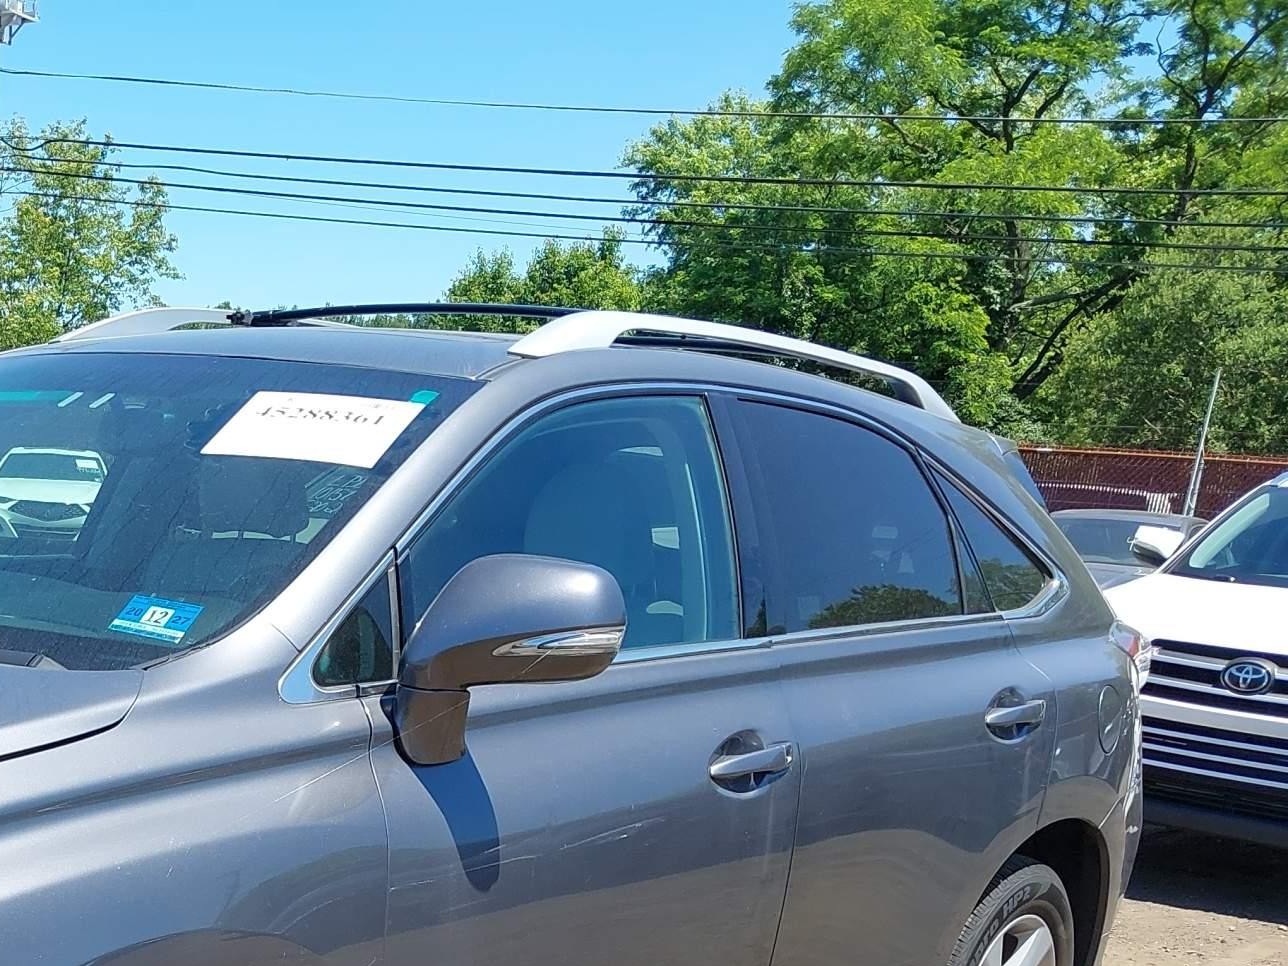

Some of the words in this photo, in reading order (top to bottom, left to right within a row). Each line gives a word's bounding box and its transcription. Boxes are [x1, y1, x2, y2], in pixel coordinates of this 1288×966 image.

[125, 607, 143, 617] 20
[144, 609, 169, 624] 12
[172, 615, 191, 625] 27
